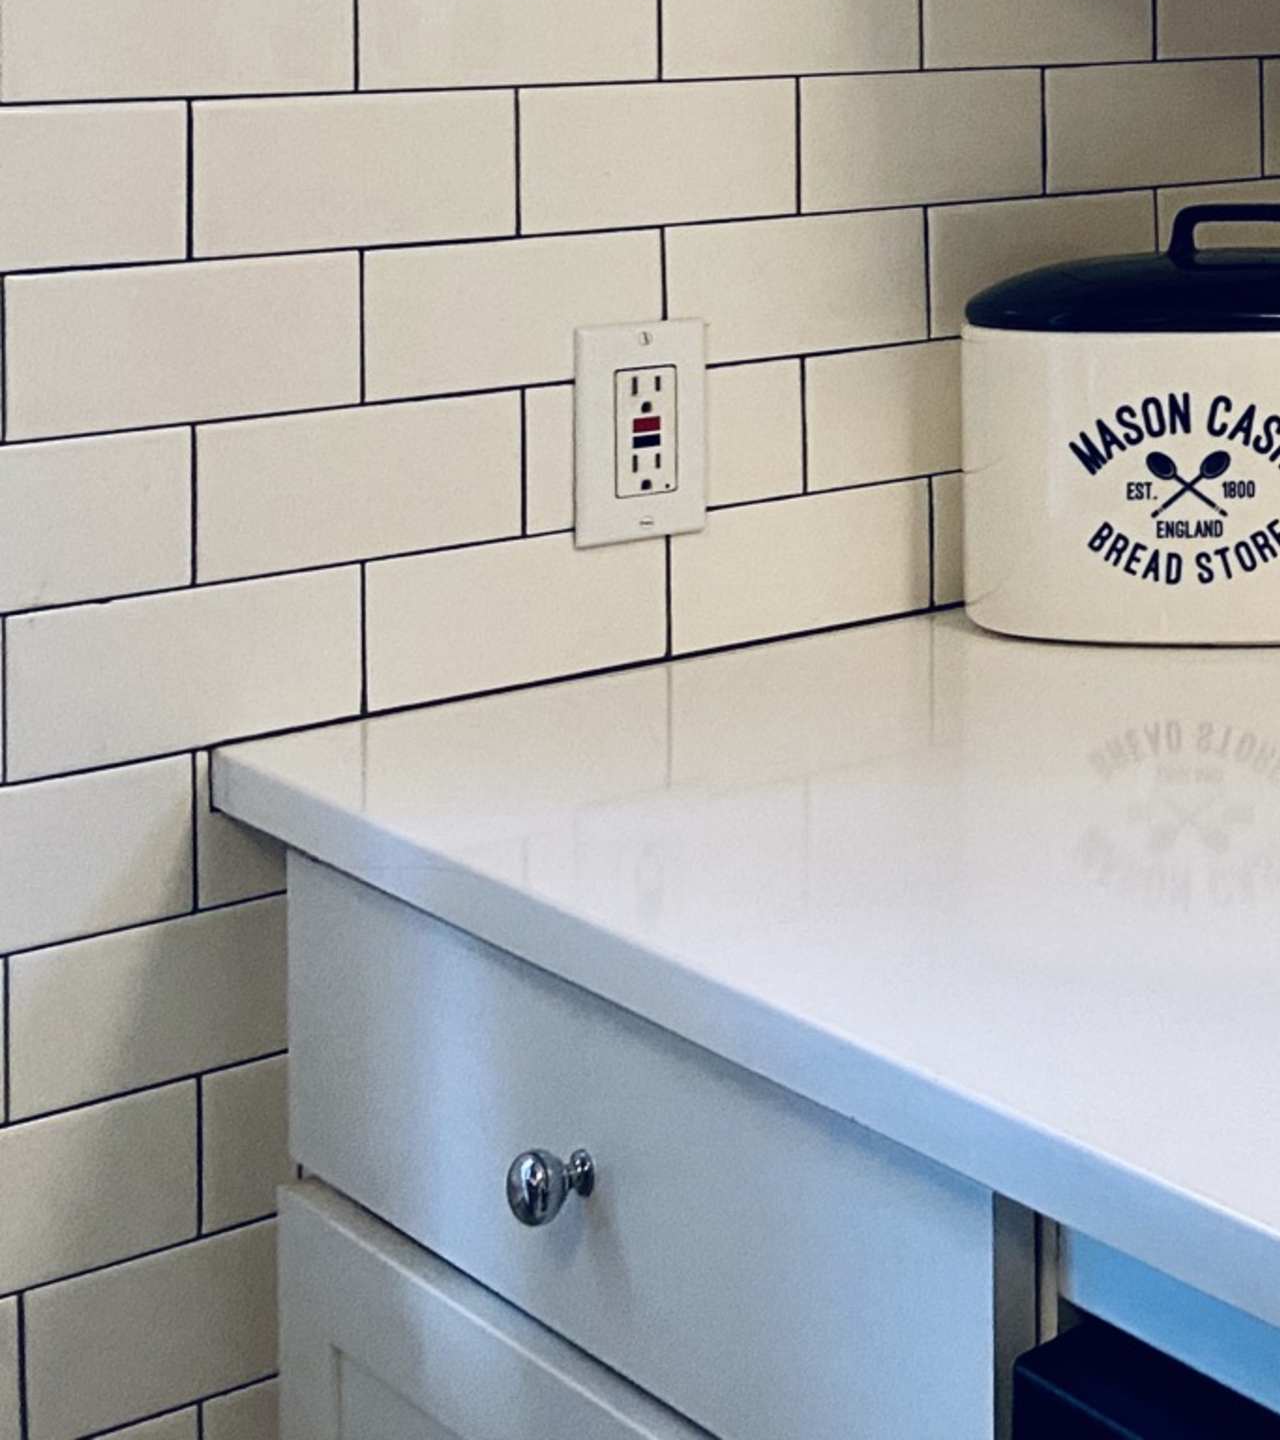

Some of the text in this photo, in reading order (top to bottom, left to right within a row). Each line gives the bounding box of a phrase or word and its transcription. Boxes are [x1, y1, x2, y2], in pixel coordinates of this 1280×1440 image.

[1069, 392, 1191, 476] MASON
[1126, 480, 1255, 501] EST. 1800
[1156, 520, 1223, 539] ENGLAND
[1087, 521, 1183, 585] BREAD
